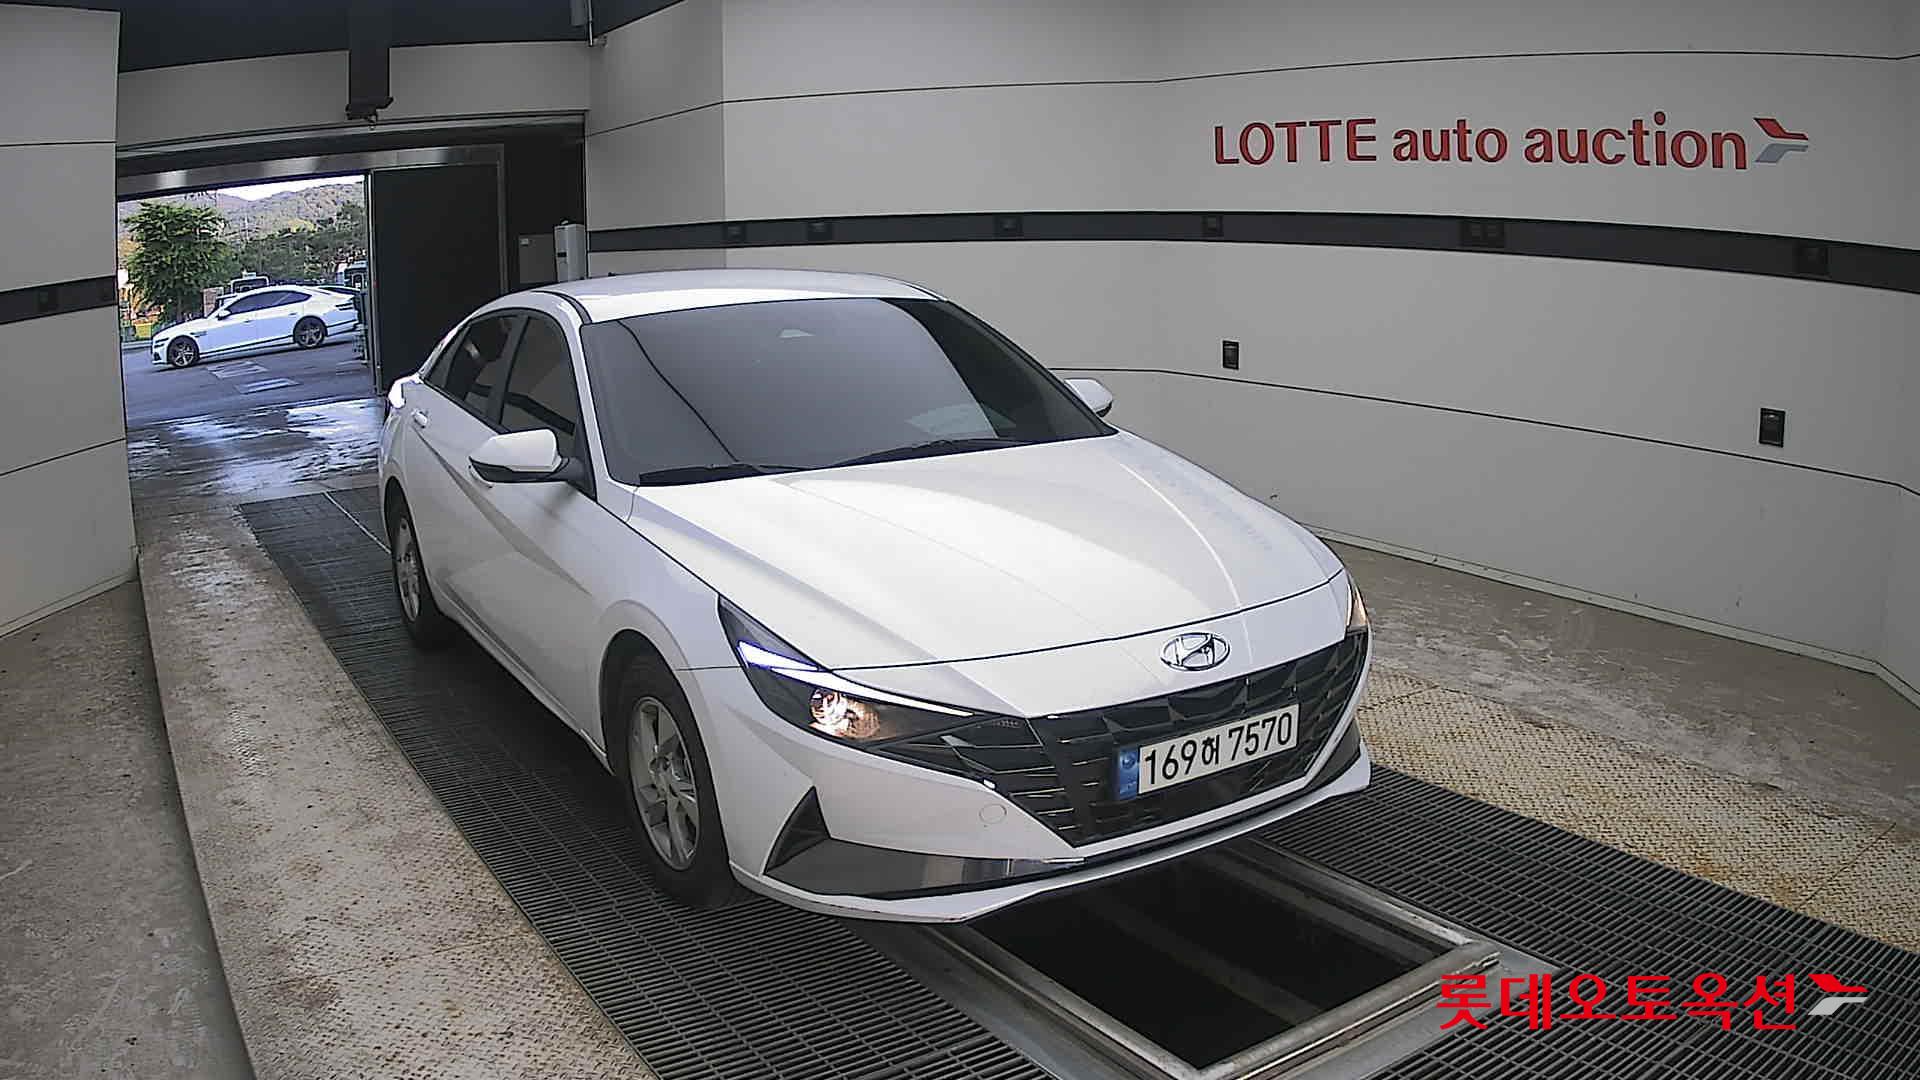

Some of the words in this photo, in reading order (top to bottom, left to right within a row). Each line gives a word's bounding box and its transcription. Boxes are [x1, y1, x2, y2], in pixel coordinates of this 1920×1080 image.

[1214, 118, 1377, 165] LOTTE
[1392, 119, 1508, 162] auto
[1524, 111, 1747, 170] auction
[1145, 734, 1220, 784] 169허
[1229, 712, 1292, 761] 7570
